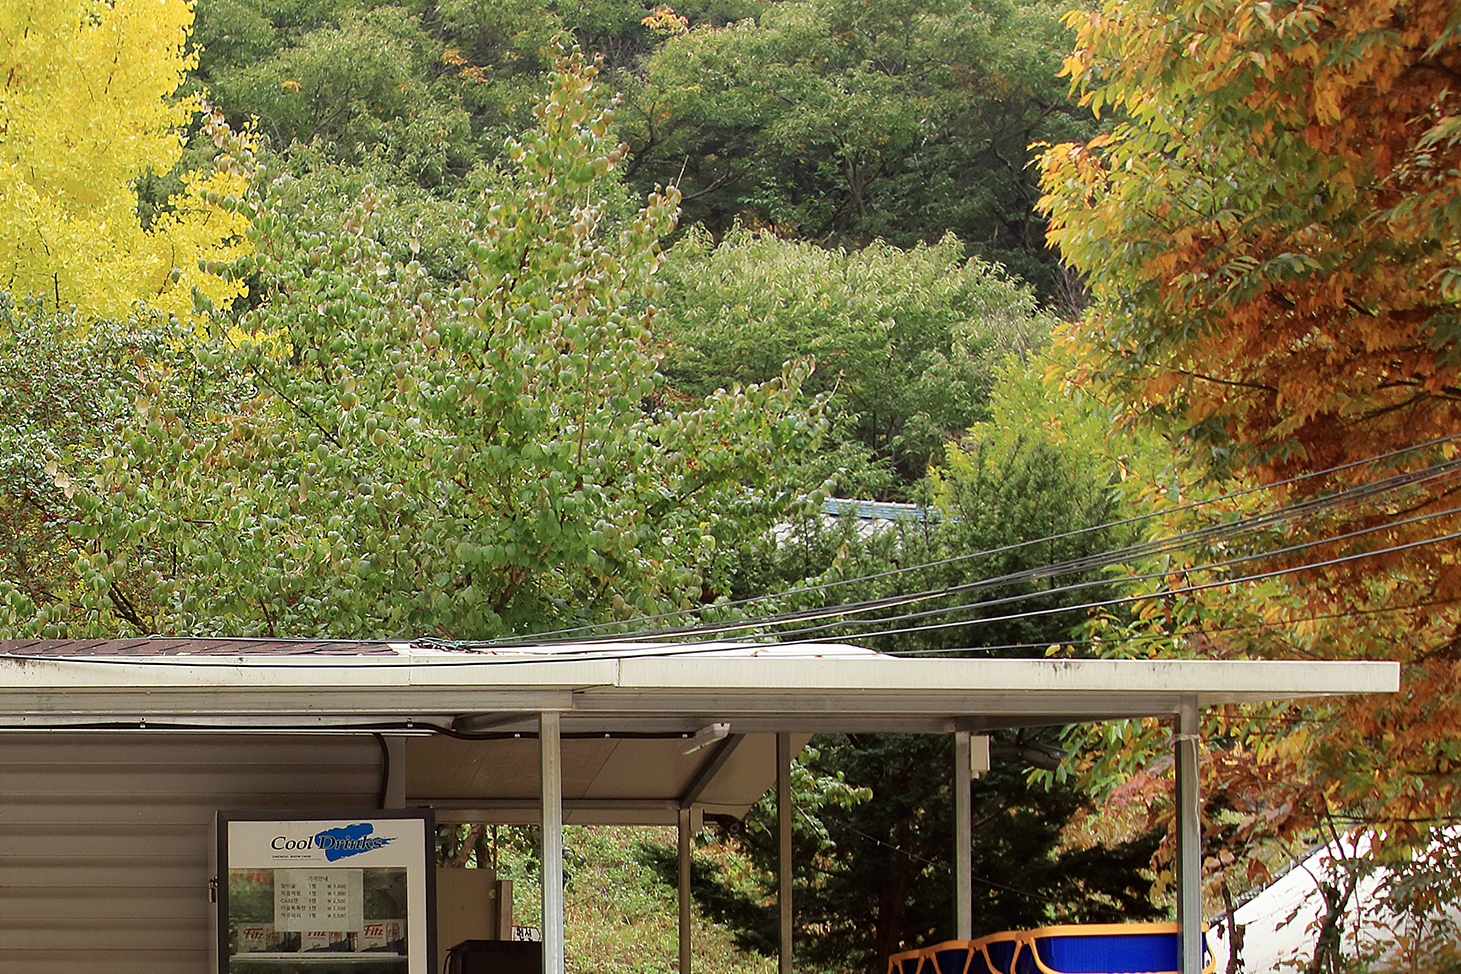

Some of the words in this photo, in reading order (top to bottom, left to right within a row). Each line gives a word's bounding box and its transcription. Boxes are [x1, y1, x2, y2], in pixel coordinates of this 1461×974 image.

[271, 835, 314, 850] Cool
[318, 835, 383, 850] Drinks
[243, 927, 263, 939] Fitz
[363, 923, 383, 936] Fitz
